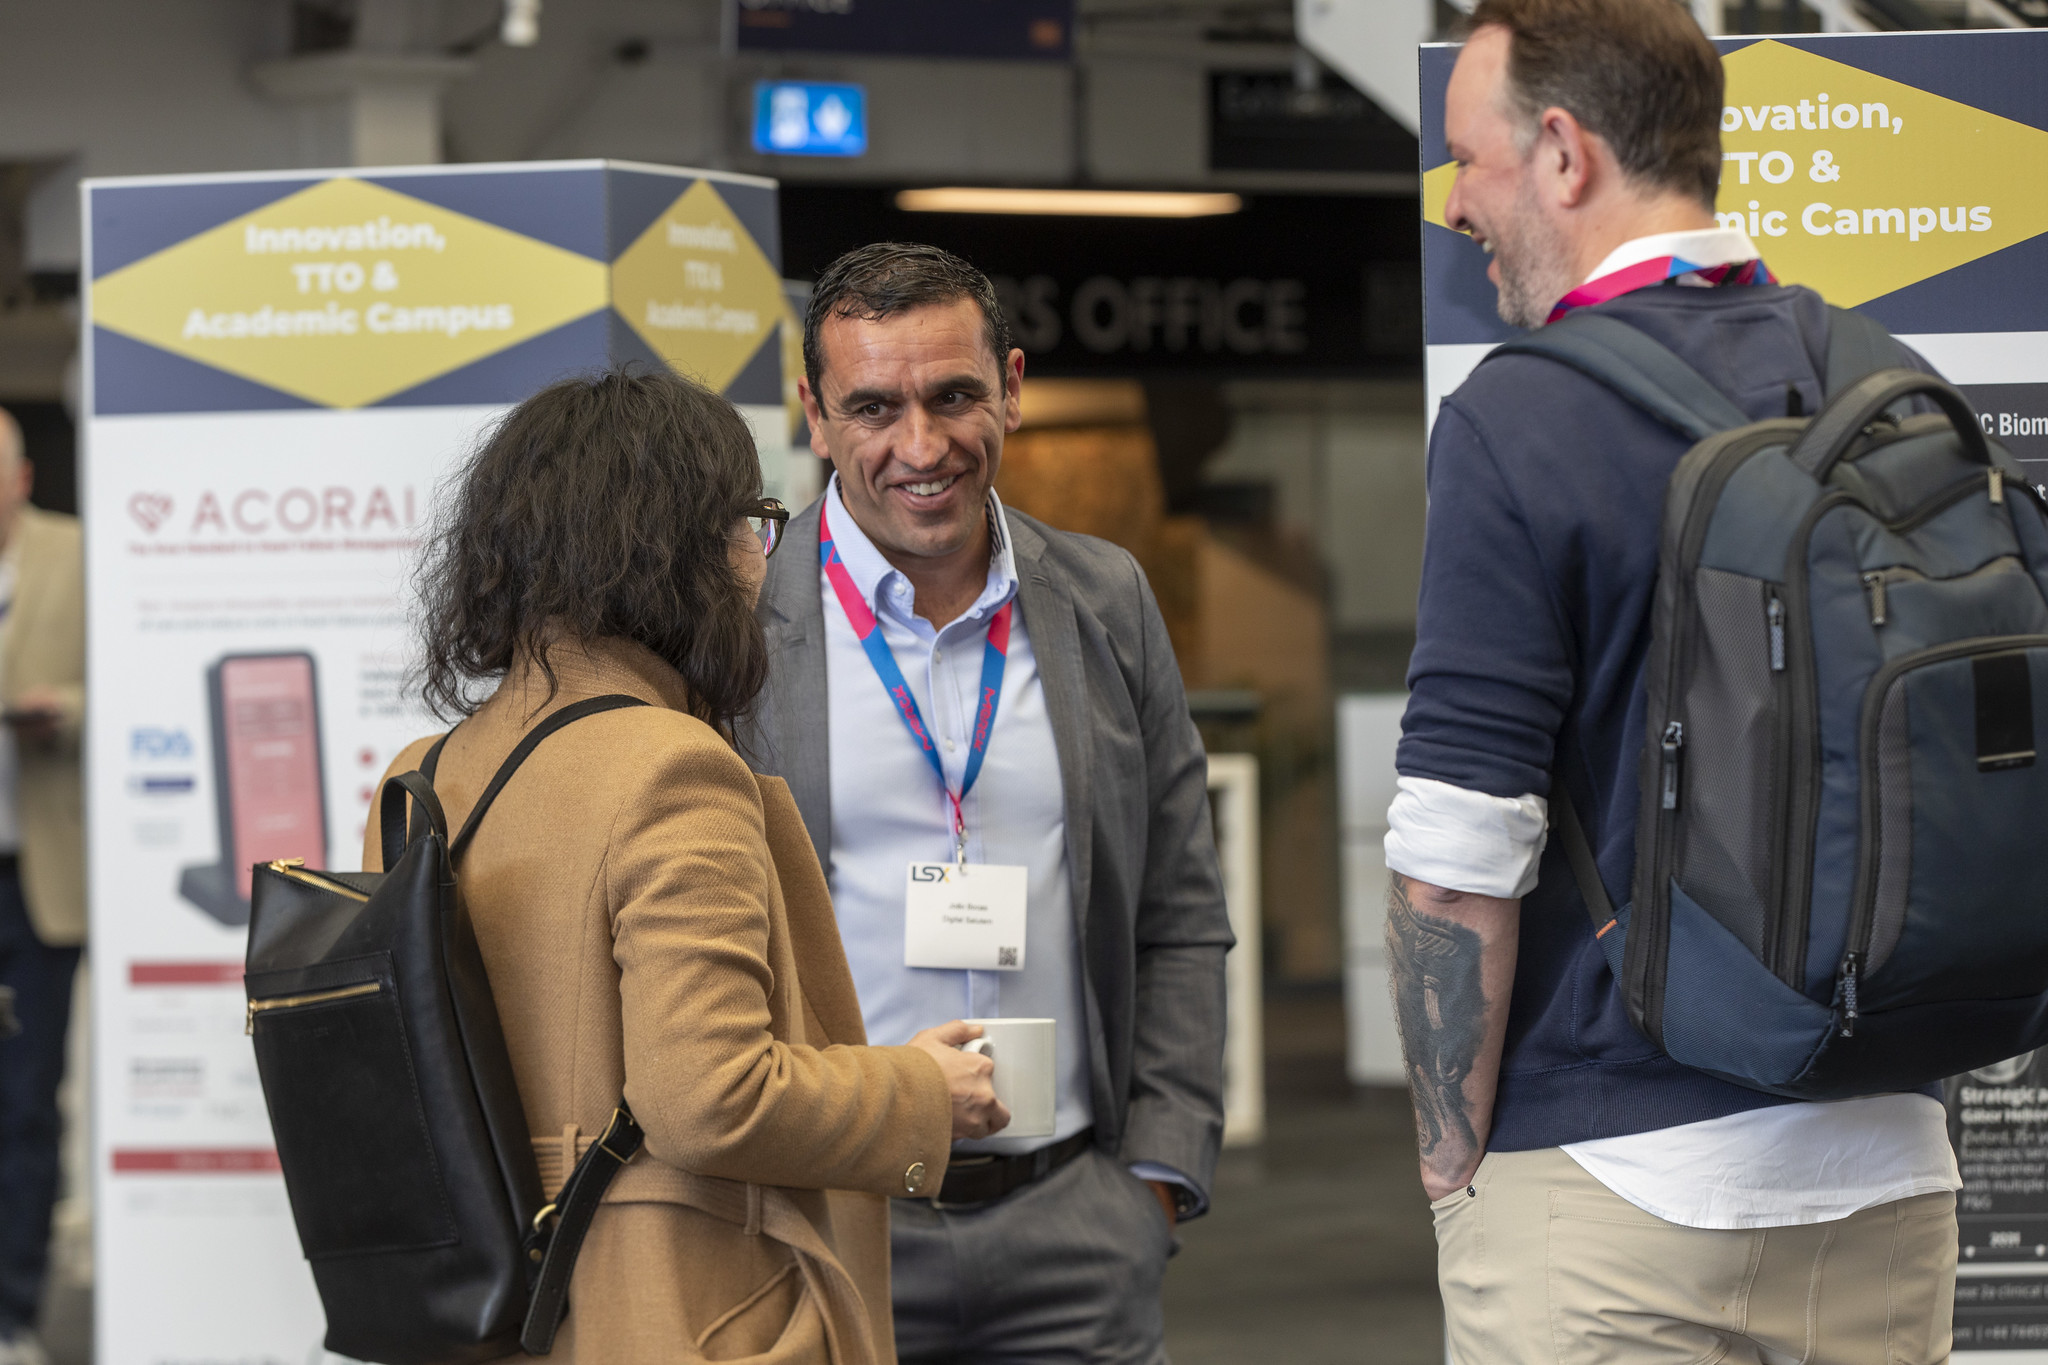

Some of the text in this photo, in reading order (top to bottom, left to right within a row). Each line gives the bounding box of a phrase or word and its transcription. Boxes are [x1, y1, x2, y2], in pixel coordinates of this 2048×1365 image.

[1809, 150, 1841, 183] &
[244, 216, 445, 253] Innovation,
[1801, 202, 1994, 242] Campus
[292, 261, 398, 293] TTO &
[183, 301, 514, 339] Academic Campus
[1071, 275, 1307, 354] OFFICE
[1976, 413, 1994, 435] C
[191, 486, 416, 534] ACORAI
[912, 865, 950, 883] LSX
